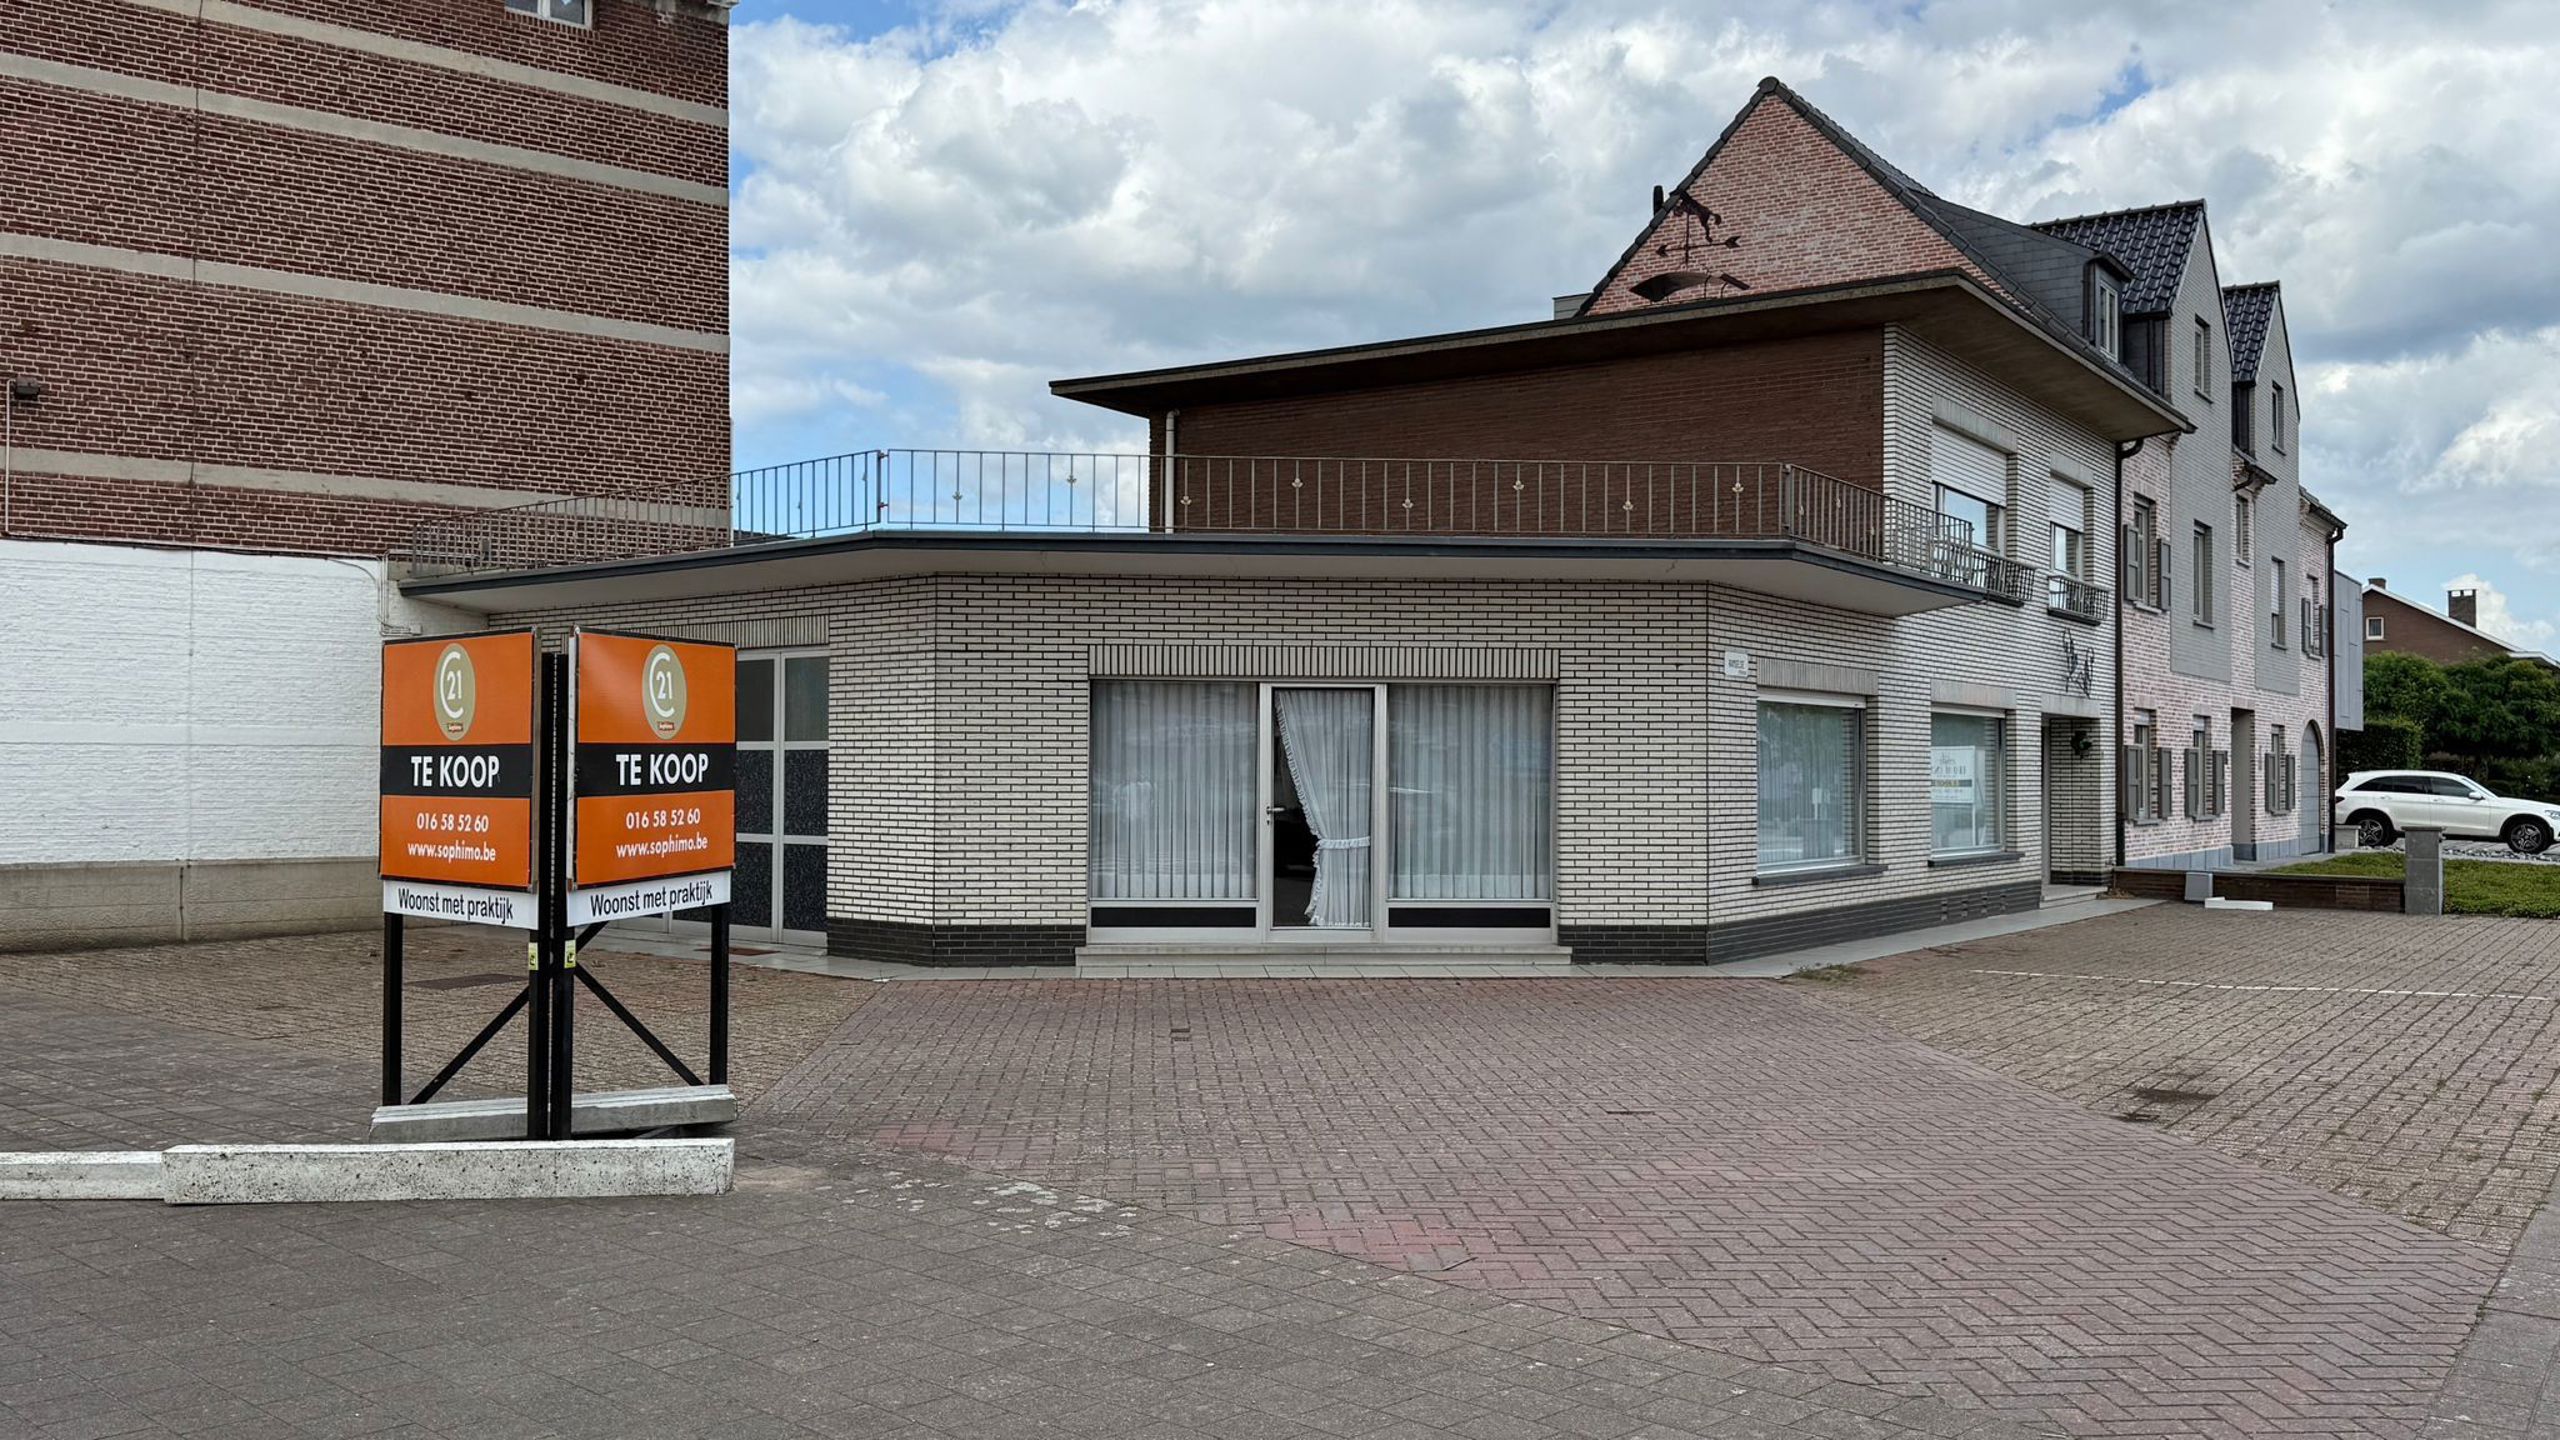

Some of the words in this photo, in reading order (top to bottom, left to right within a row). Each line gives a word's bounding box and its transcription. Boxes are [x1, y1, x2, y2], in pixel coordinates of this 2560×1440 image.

[411, 755, 433, 787] TE
[440, 755, 500, 788] KOOP
[616, 754, 642, 786] TE
[650, 753, 709, 785] KOOP
[416, 812, 438, 830] 016
[440, 813, 455, 831] 58
[457, 814, 471, 832] 52
[474, 815, 489, 832] 60
[626, 811, 649, 829] 016
[653, 810, 667, 828] 58
[670, 809, 684, 826] 52
[687, 808, 701, 825] 60
[407, 840, 496, 863] www.sophimo.be
[616, 832, 708, 858] www.sophimo.be
[398, 888, 440, 912] Woonst
[442, 894, 465, 916] met
[467, 895, 514, 924] praktijk
[590, 889, 640, 917] Woonst
[643, 886, 667, 909] met
[669, 880, 713, 910] praktijk
